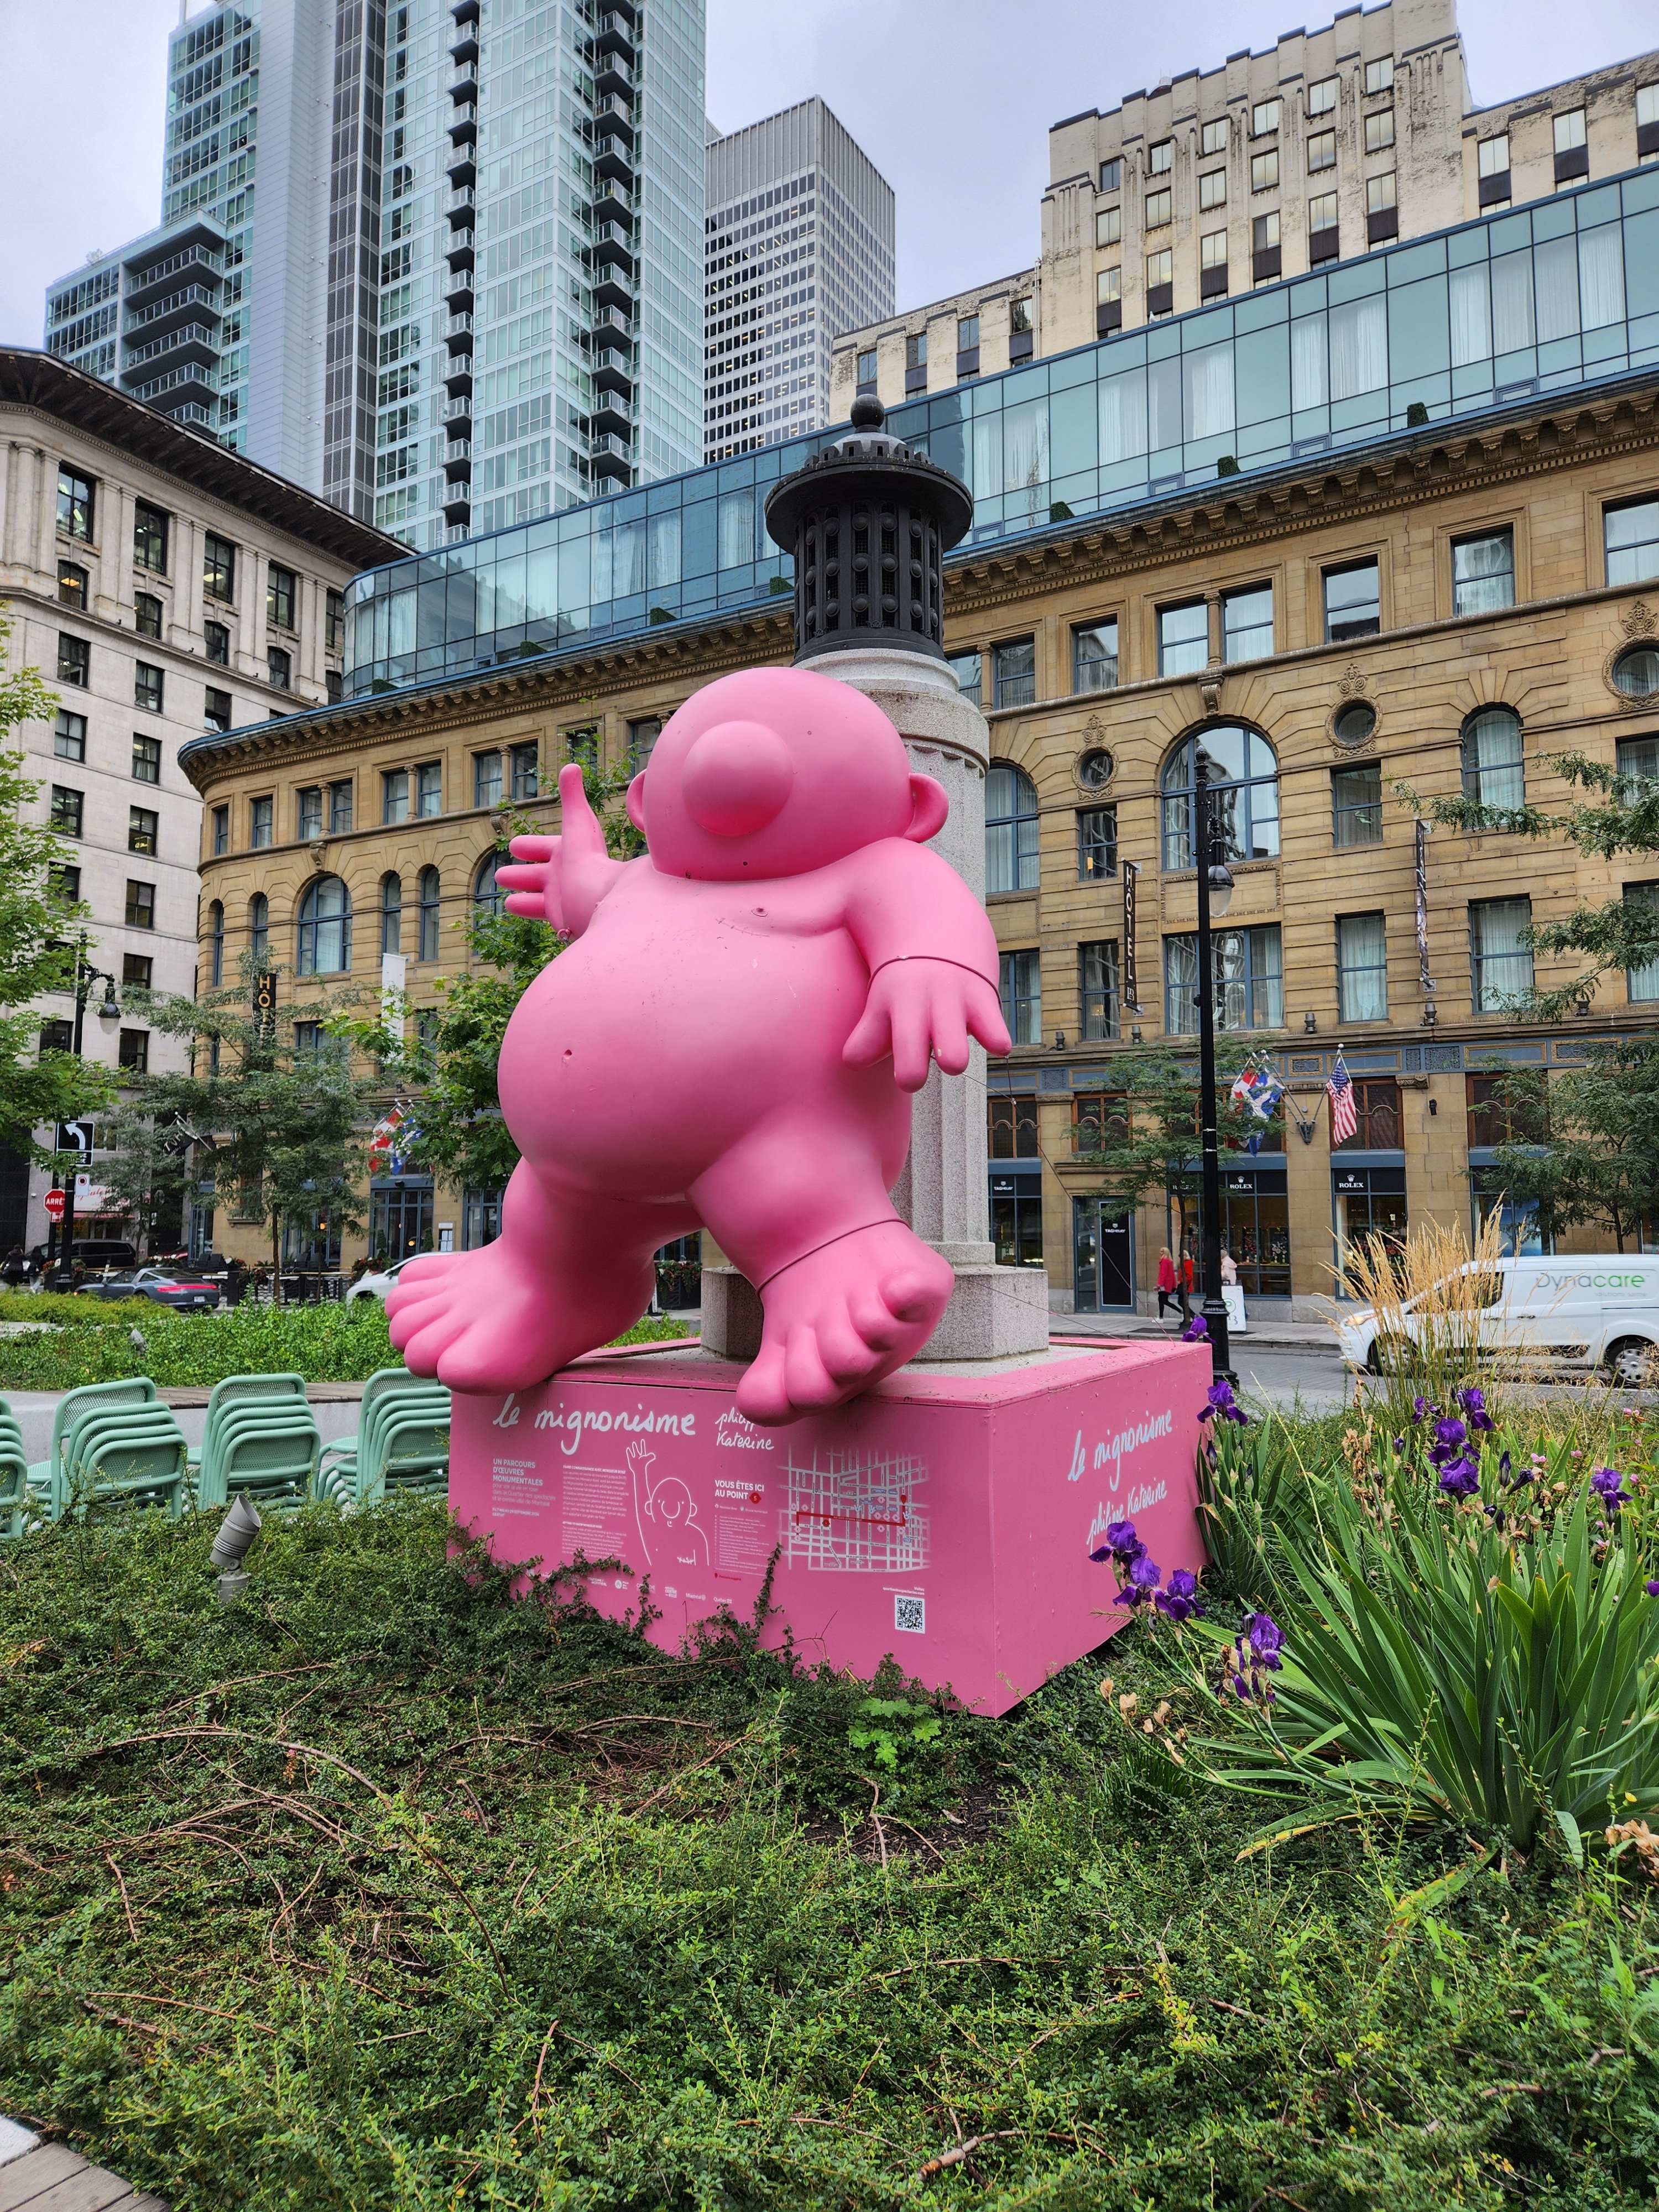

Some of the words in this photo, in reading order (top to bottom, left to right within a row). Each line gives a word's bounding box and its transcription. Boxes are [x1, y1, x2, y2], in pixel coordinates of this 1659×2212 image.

[46, 1197, 65, 1206] ARRÊ
[1536, 1272, 1645, 1291] Dynacare
[492, 1392, 520, 1428] le
[534, 1402, 696, 1455] mignonisme
[1094, 1410, 1172, 1491] mignonisme
[503, 1459, 536, 1469] PARCOURS
[493, 1475, 543, 1486] MONUMENTALES
[714, 1479, 734, 1489] VOUS
[736, 1480, 753, 1490] ÊTES
[755, 1484, 764, 1492] ICI
[727, 1490, 748, 1500] POINT
